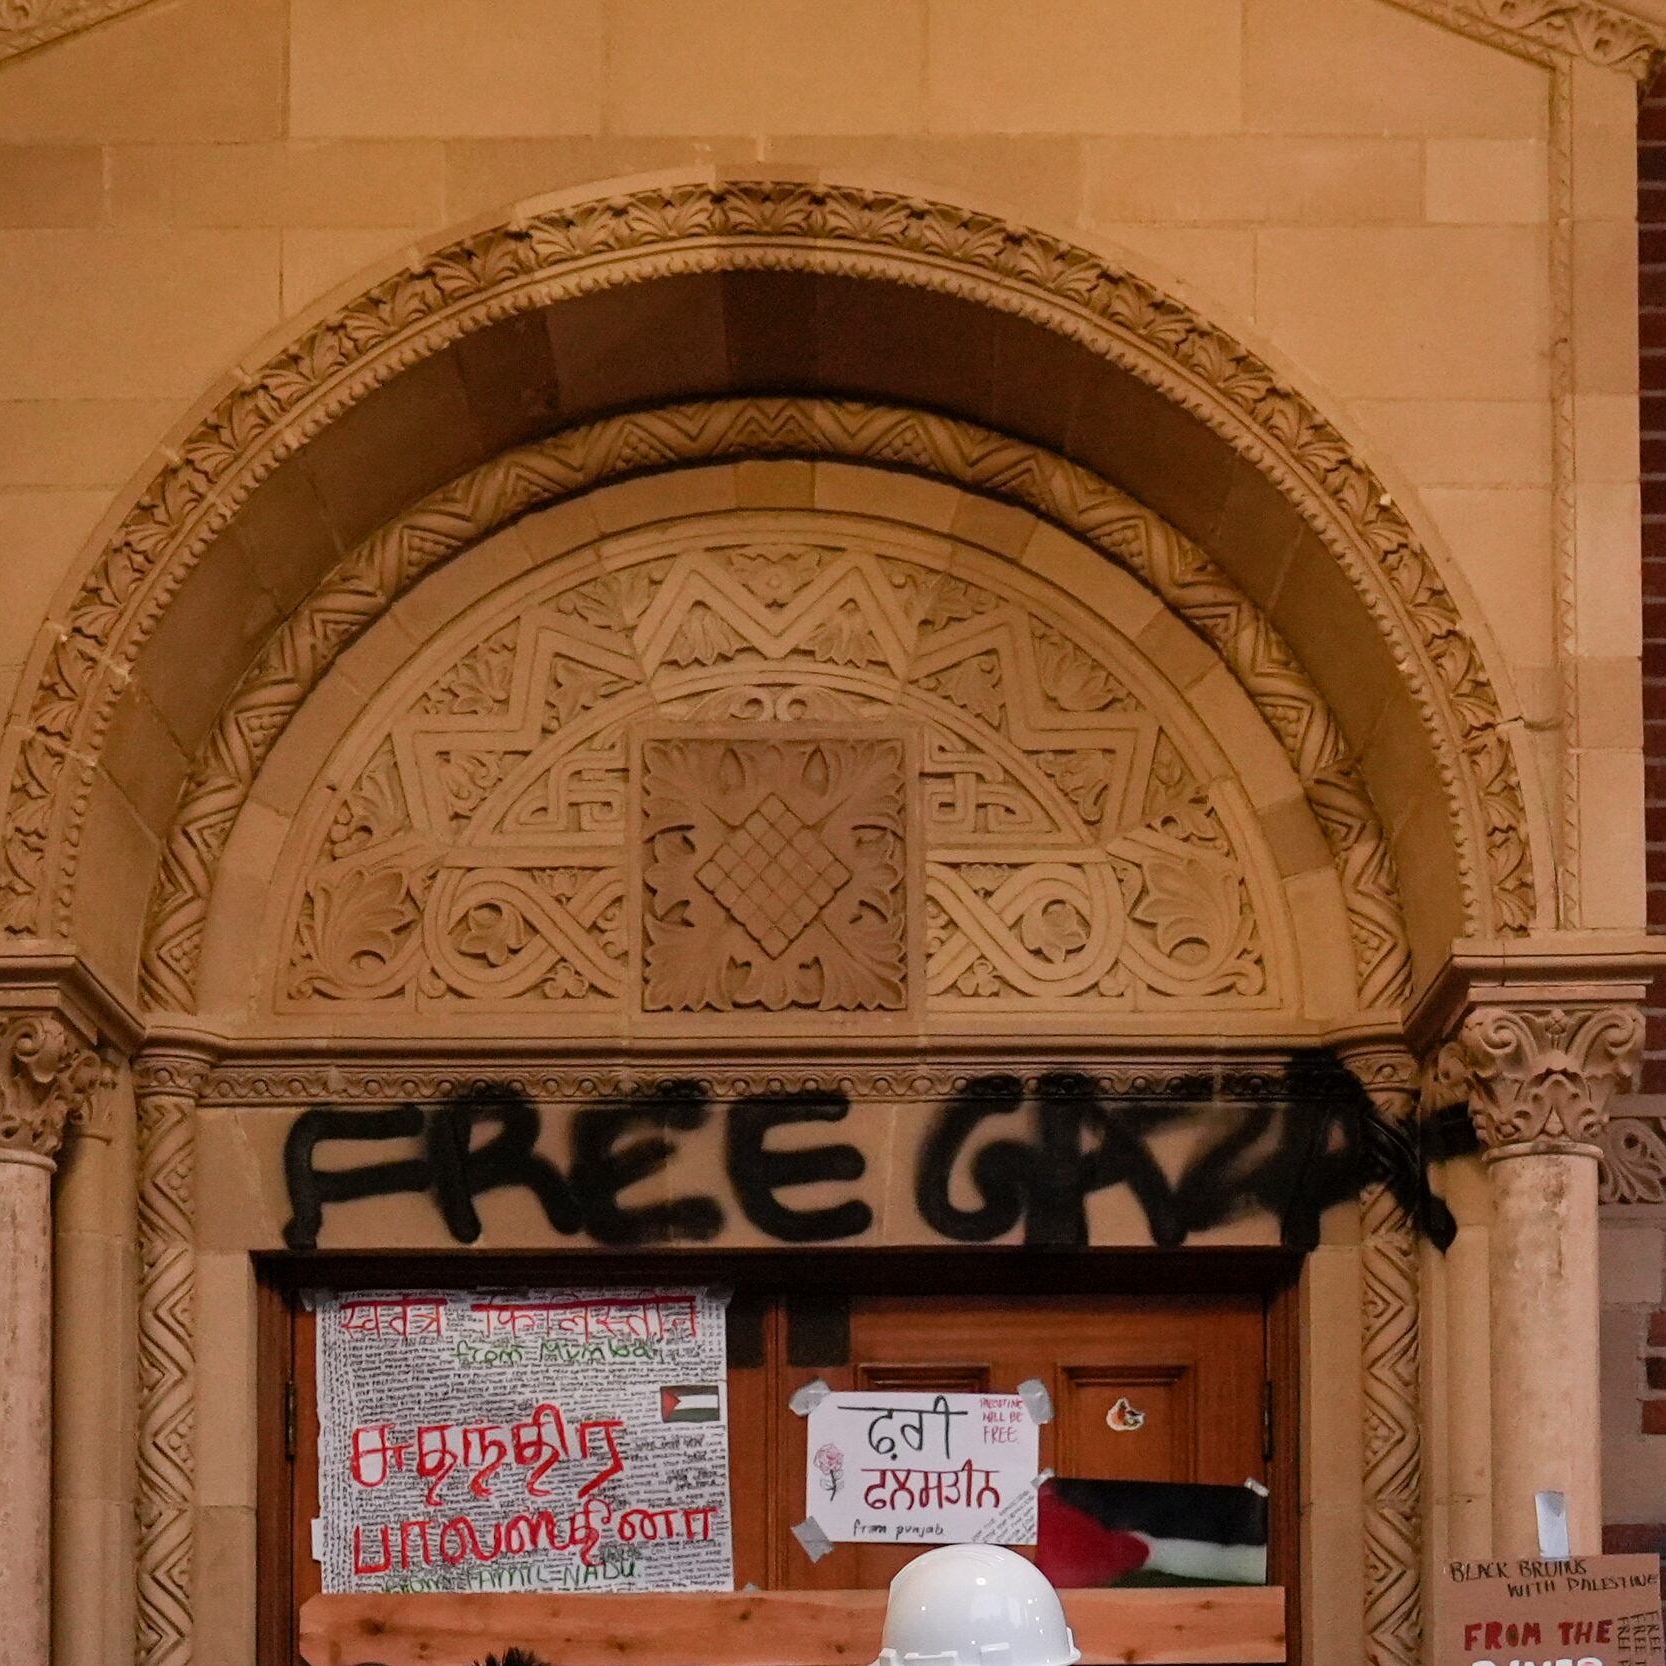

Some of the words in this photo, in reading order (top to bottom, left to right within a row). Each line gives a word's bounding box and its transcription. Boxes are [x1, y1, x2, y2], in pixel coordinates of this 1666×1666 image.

[281, 1078, 874, 1250] FREE
[913, 1066, 1461, 1255] GAZA
[983, 1426, 1018, 1445] FREE
[1449, 1561, 1507, 1583] BLACK
[1519, 1560, 1587, 1578] BRUINS
[1507, 1581, 1556, 1599] WITH
[1568, 1574, 1659, 1593] PALESTINE
[1464, 1621, 1542, 1652] FROM
[1557, 1619, 1613, 1645] THE
